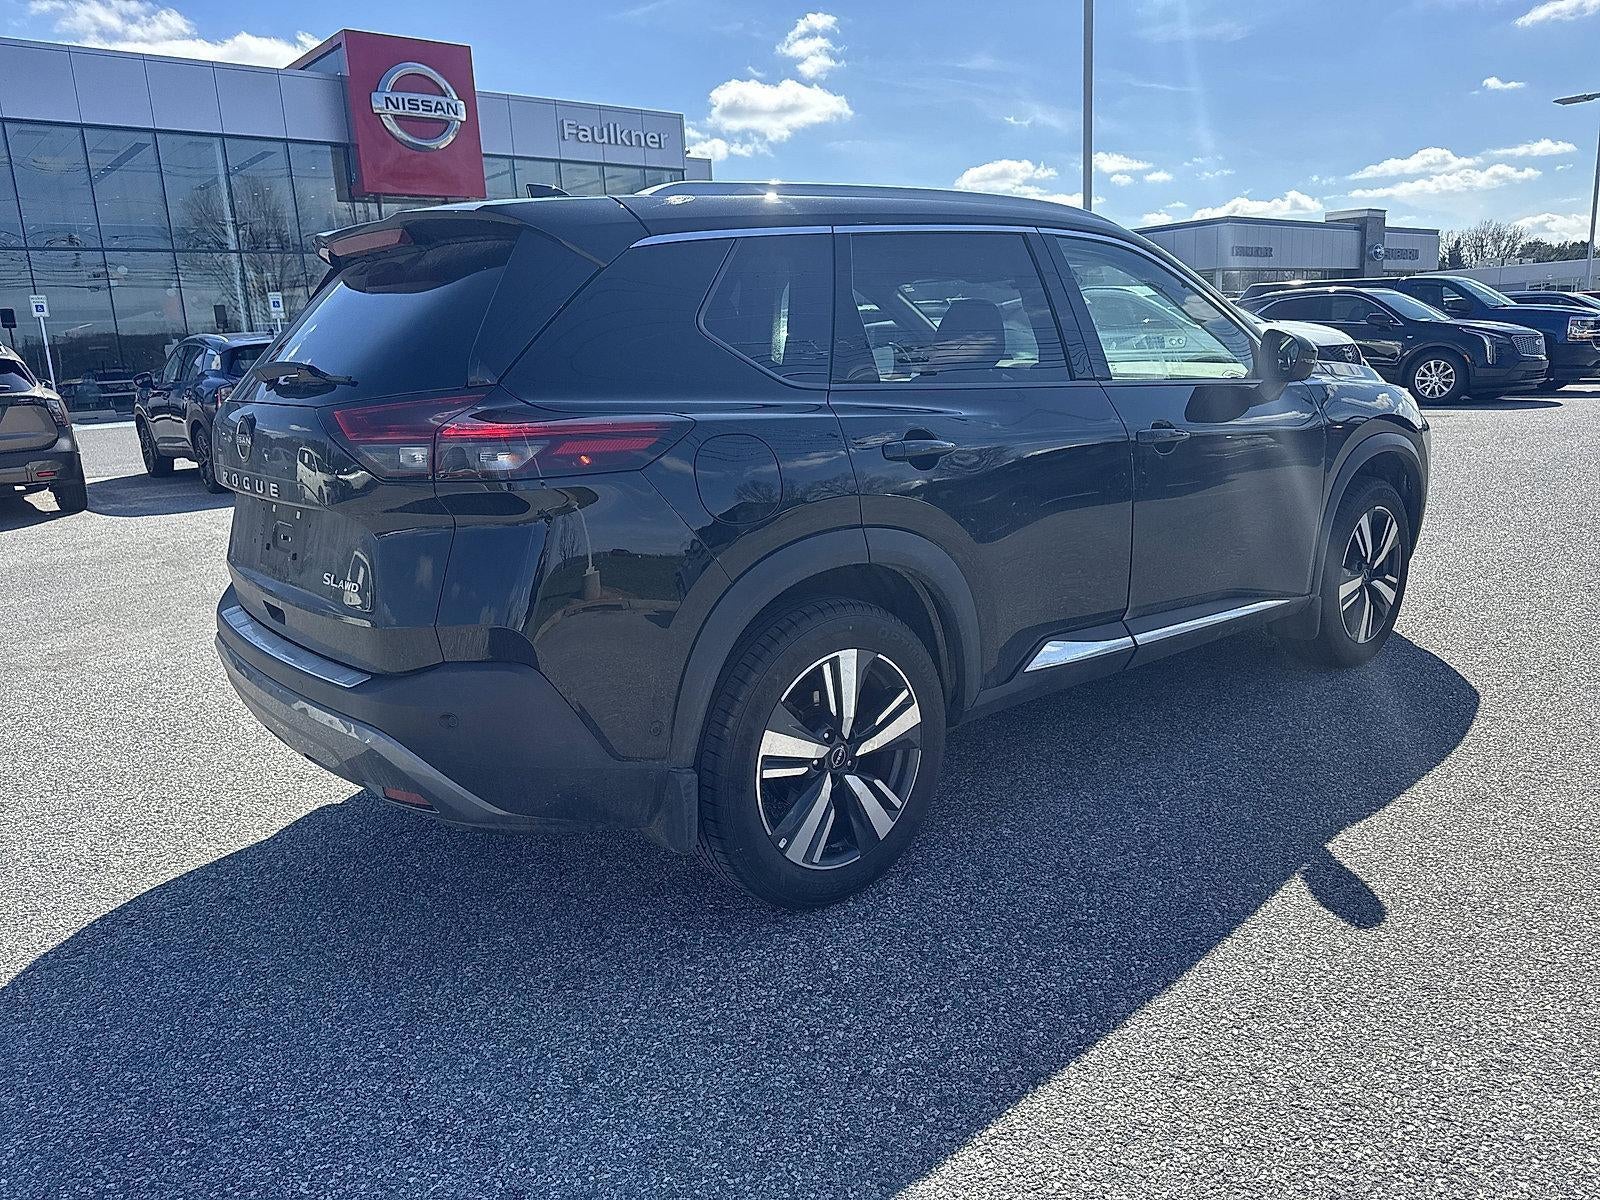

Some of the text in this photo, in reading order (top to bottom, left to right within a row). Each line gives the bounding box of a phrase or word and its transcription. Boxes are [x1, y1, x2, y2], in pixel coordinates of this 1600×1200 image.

[384, 96, 459, 116] NISSAN
[562, 118, 668, 149] Faulkner
[1384, 247, 1420, 261] SUBARU
[222, 471, 280, 498] ROGUE
